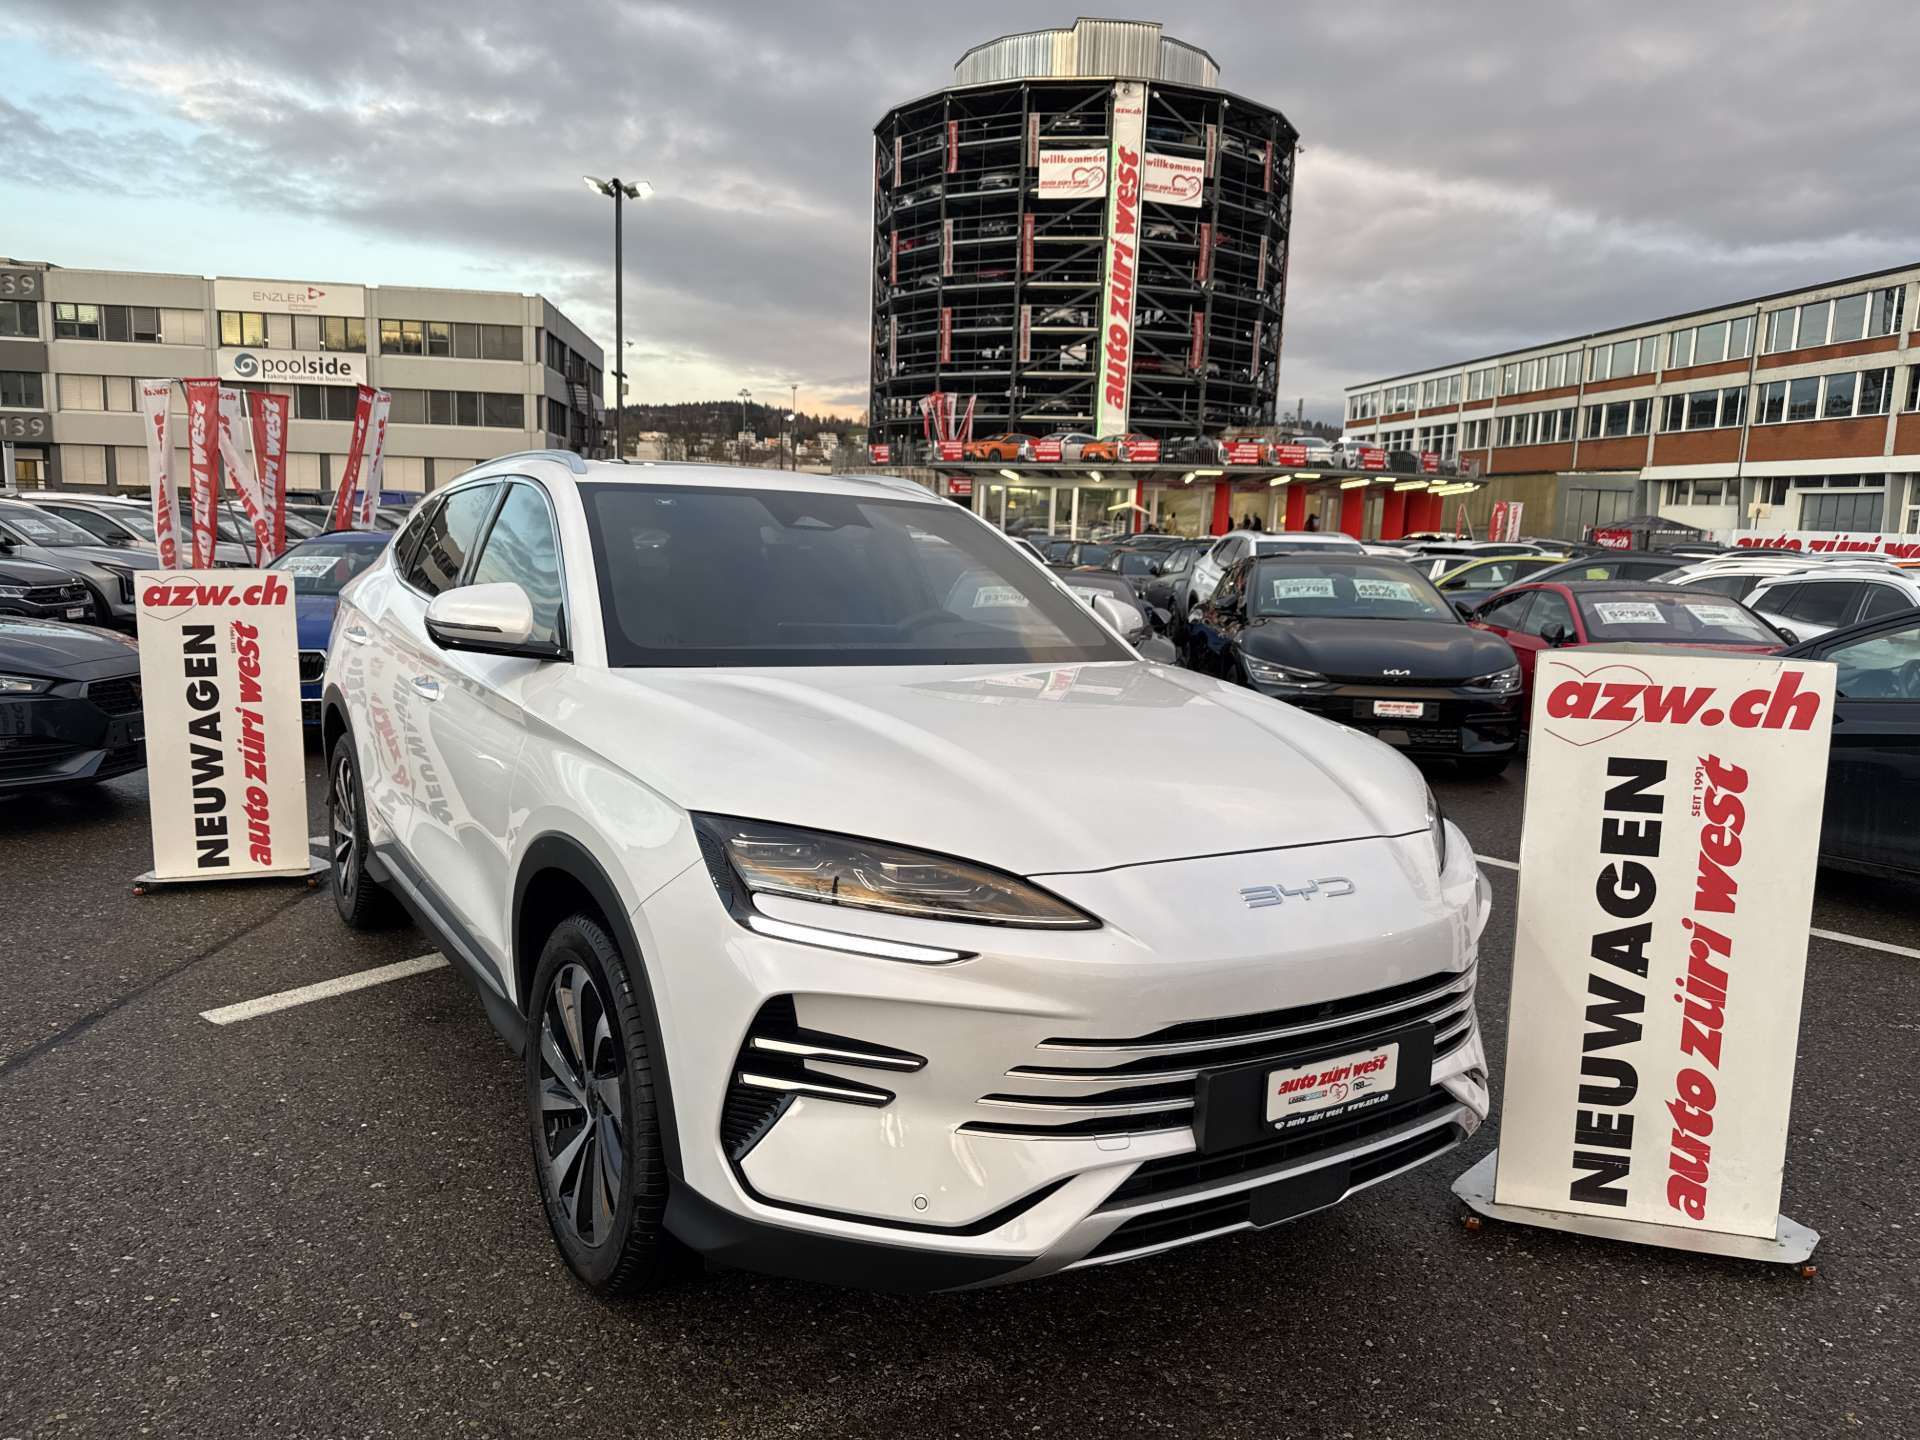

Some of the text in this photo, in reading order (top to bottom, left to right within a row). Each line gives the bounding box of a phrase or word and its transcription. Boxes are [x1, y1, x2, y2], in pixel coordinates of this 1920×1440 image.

[1041, 154, 1106, 165] willkommen
[1145, 158, 1203, 174] willkommen
[252, 290, 307, 304] ENZLER
[1105, 145, 1139, 411] auto züri west
[262, 355, 352, 379] poolside
[191, 399, 208, 465] west
[263, 398, 282, 456] west
[142, 574, 289, 608] azw.ch
[1546, 671, 1821, 732] azw.ch
[181, 624, 230, 869] NEUWAGEN
[230, 620, 272, 867] auto züri west
[1691, 766, 1704, 817] SEIT 1991
[1239, 876, 1356, 909] BYD
[1569, 756, 1668, 1208] NEUWAGEN
[1665, 753, 1749, 1222] auto züri west
[1277, 1053, 1389, 1096] auto züri west
[1286, 1116, 1306, 1128] auto
[1306, 1112, 1324, 1123] züri
[1325, 1107, 1344, 1118] west
